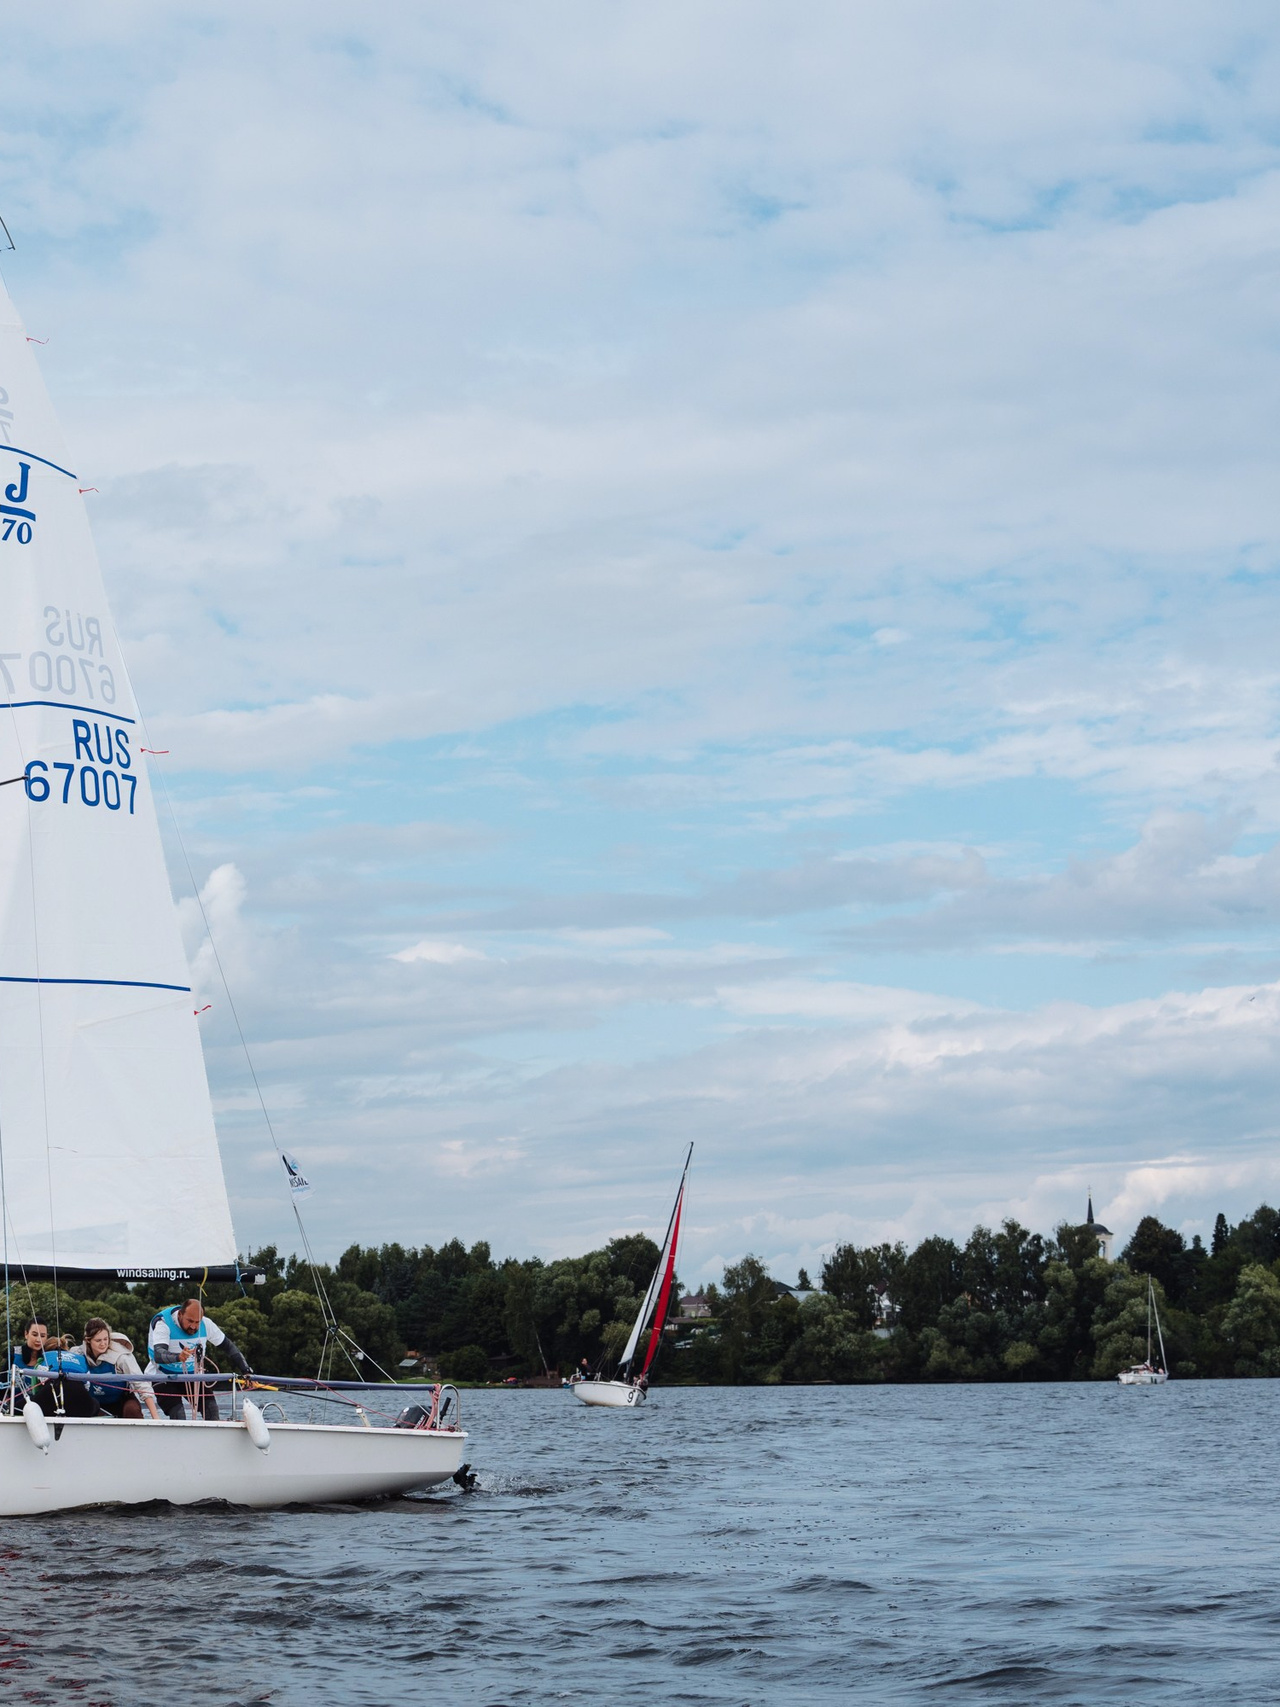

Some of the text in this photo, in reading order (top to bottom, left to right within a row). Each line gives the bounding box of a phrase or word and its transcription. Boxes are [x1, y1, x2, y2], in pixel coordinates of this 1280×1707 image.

[4, 461, 31, 503] J
[1, 517, 33, 545] 70
[72, 718, 131, 769] RUS
[24, 760, 138, 815] 67007
